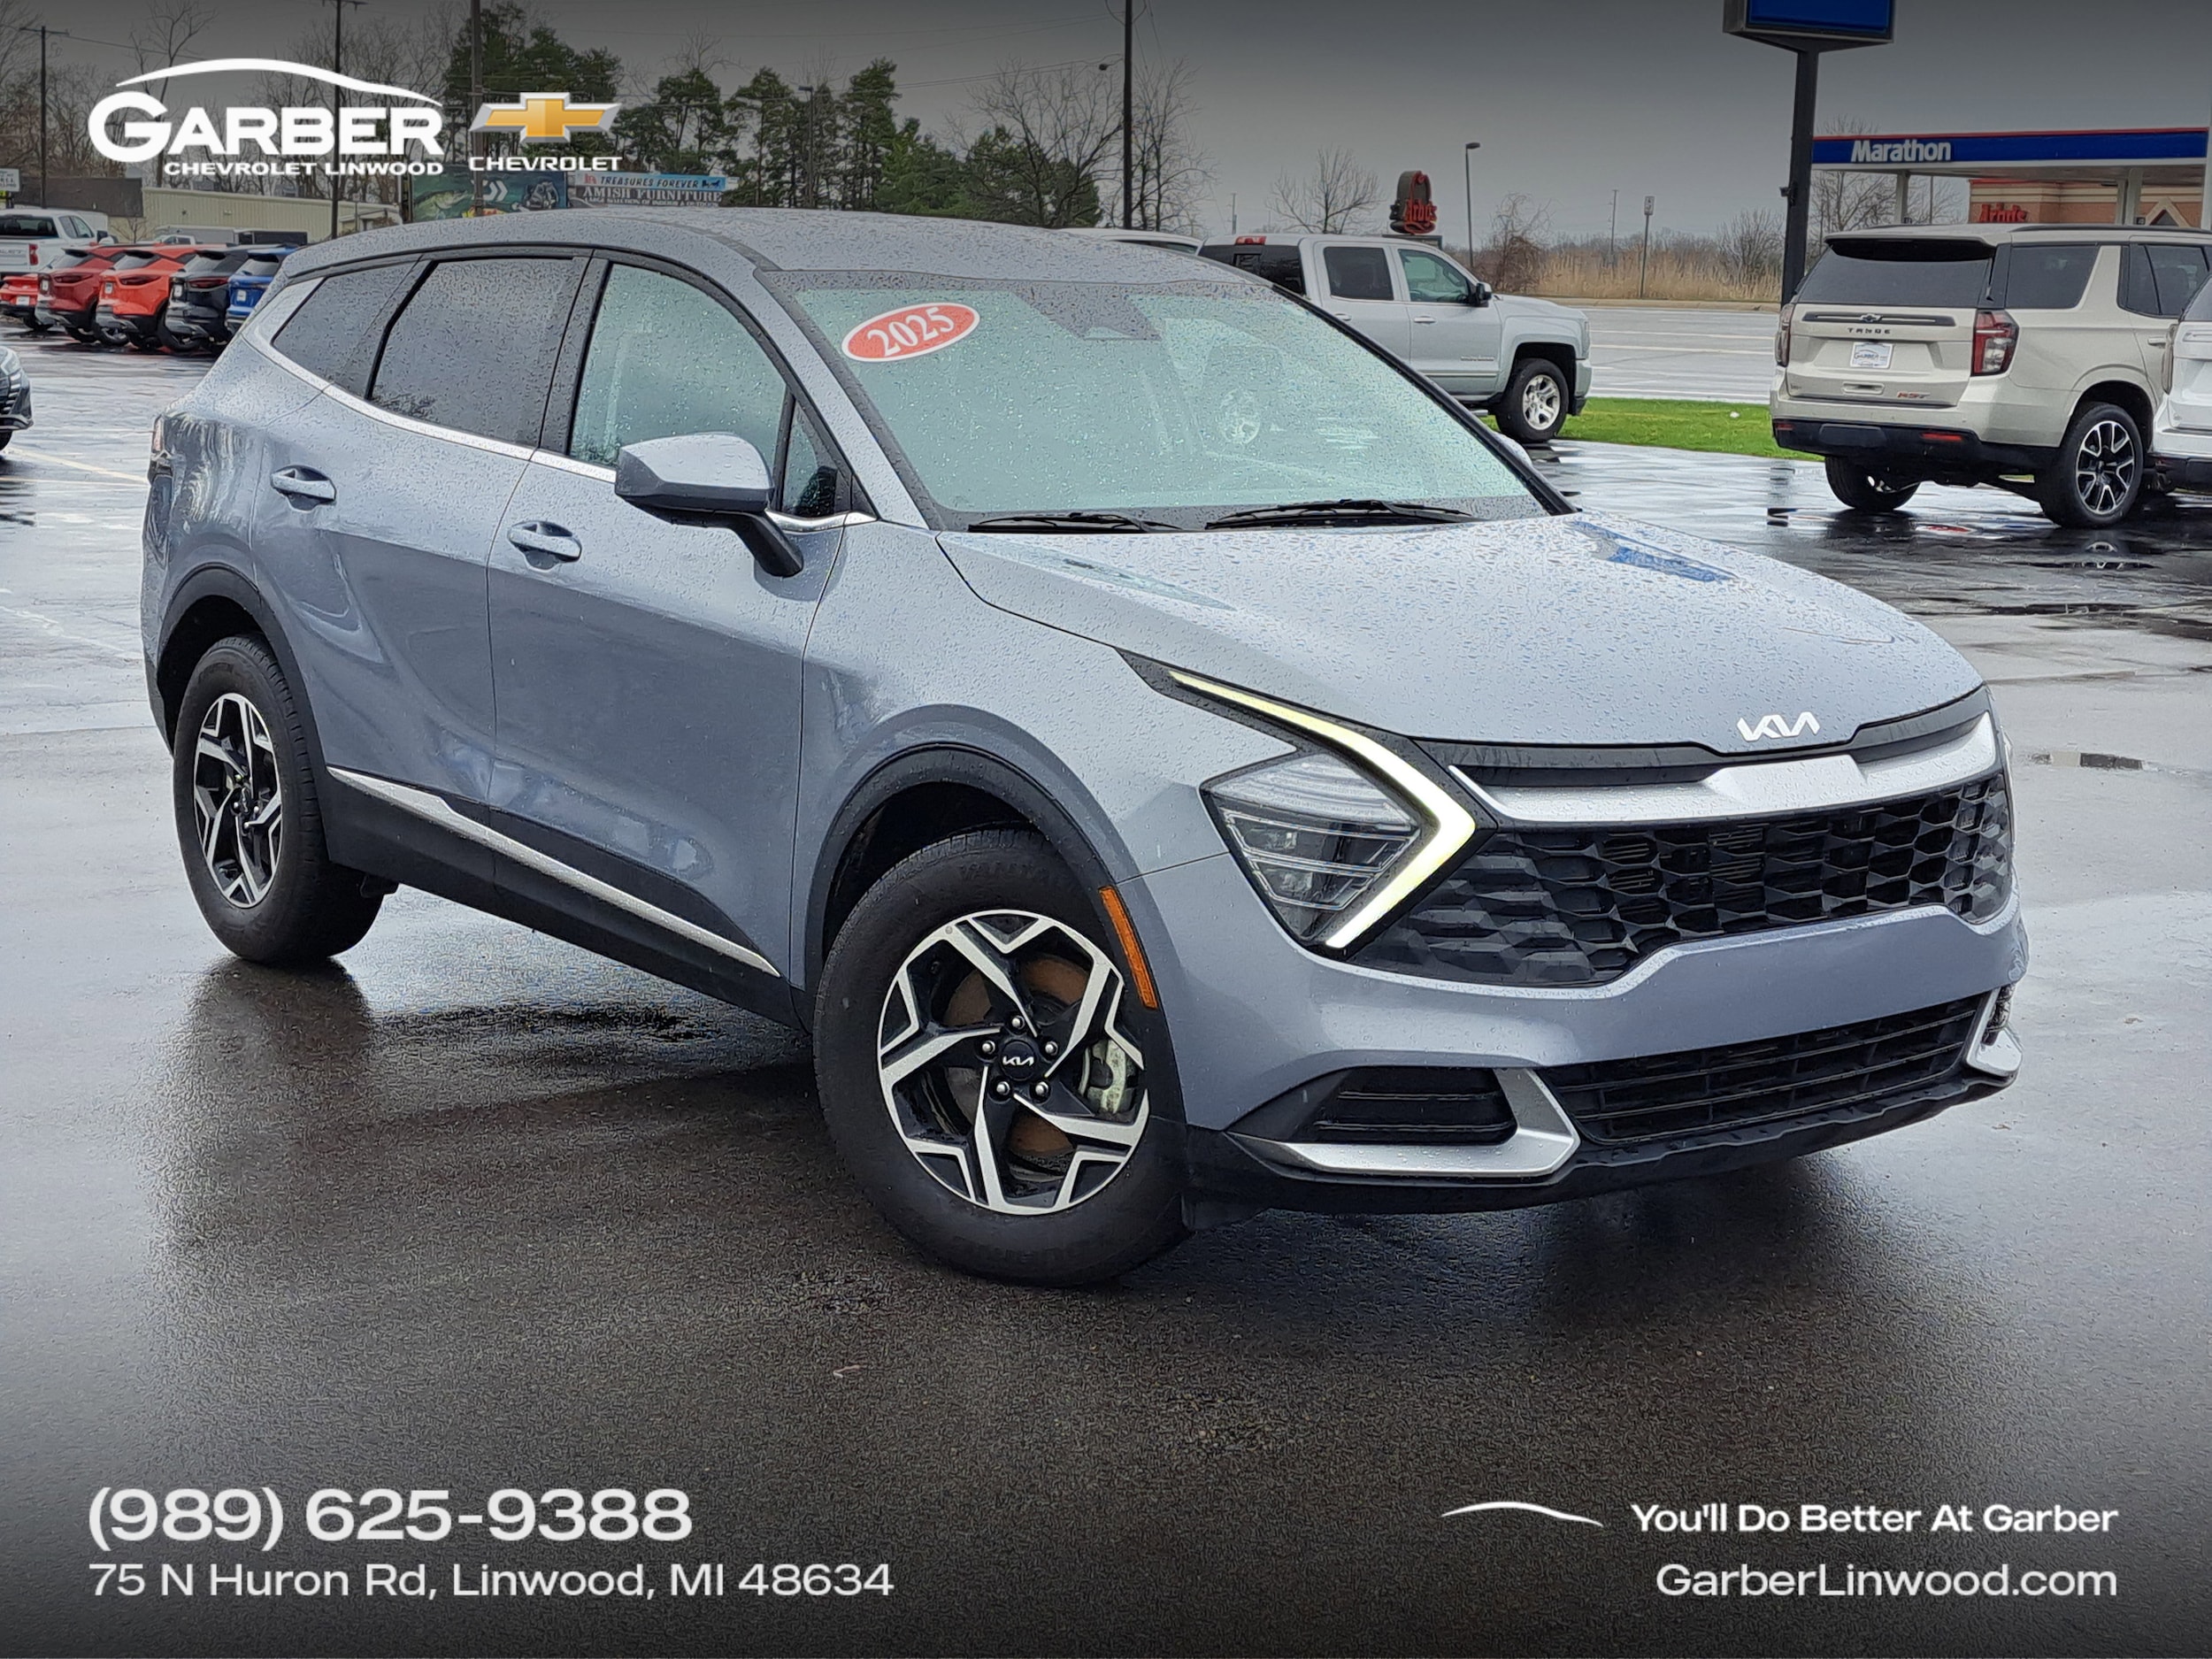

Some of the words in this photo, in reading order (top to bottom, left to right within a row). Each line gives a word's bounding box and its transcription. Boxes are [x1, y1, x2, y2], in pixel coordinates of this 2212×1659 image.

[1850, 139, 1952, 163] Marathon
[600, 176, 653, 187] TREASURES
[657, 180, 698, 188] FOREVER
[582, 186, 632, 199] AMISH
[636, 188, 723, 203] FURNITURE
[867, 306, 955, 357] 2025
[1737, 711, 1821, 741] KIA
[1002, 1056, 1034, 1067] KIA
